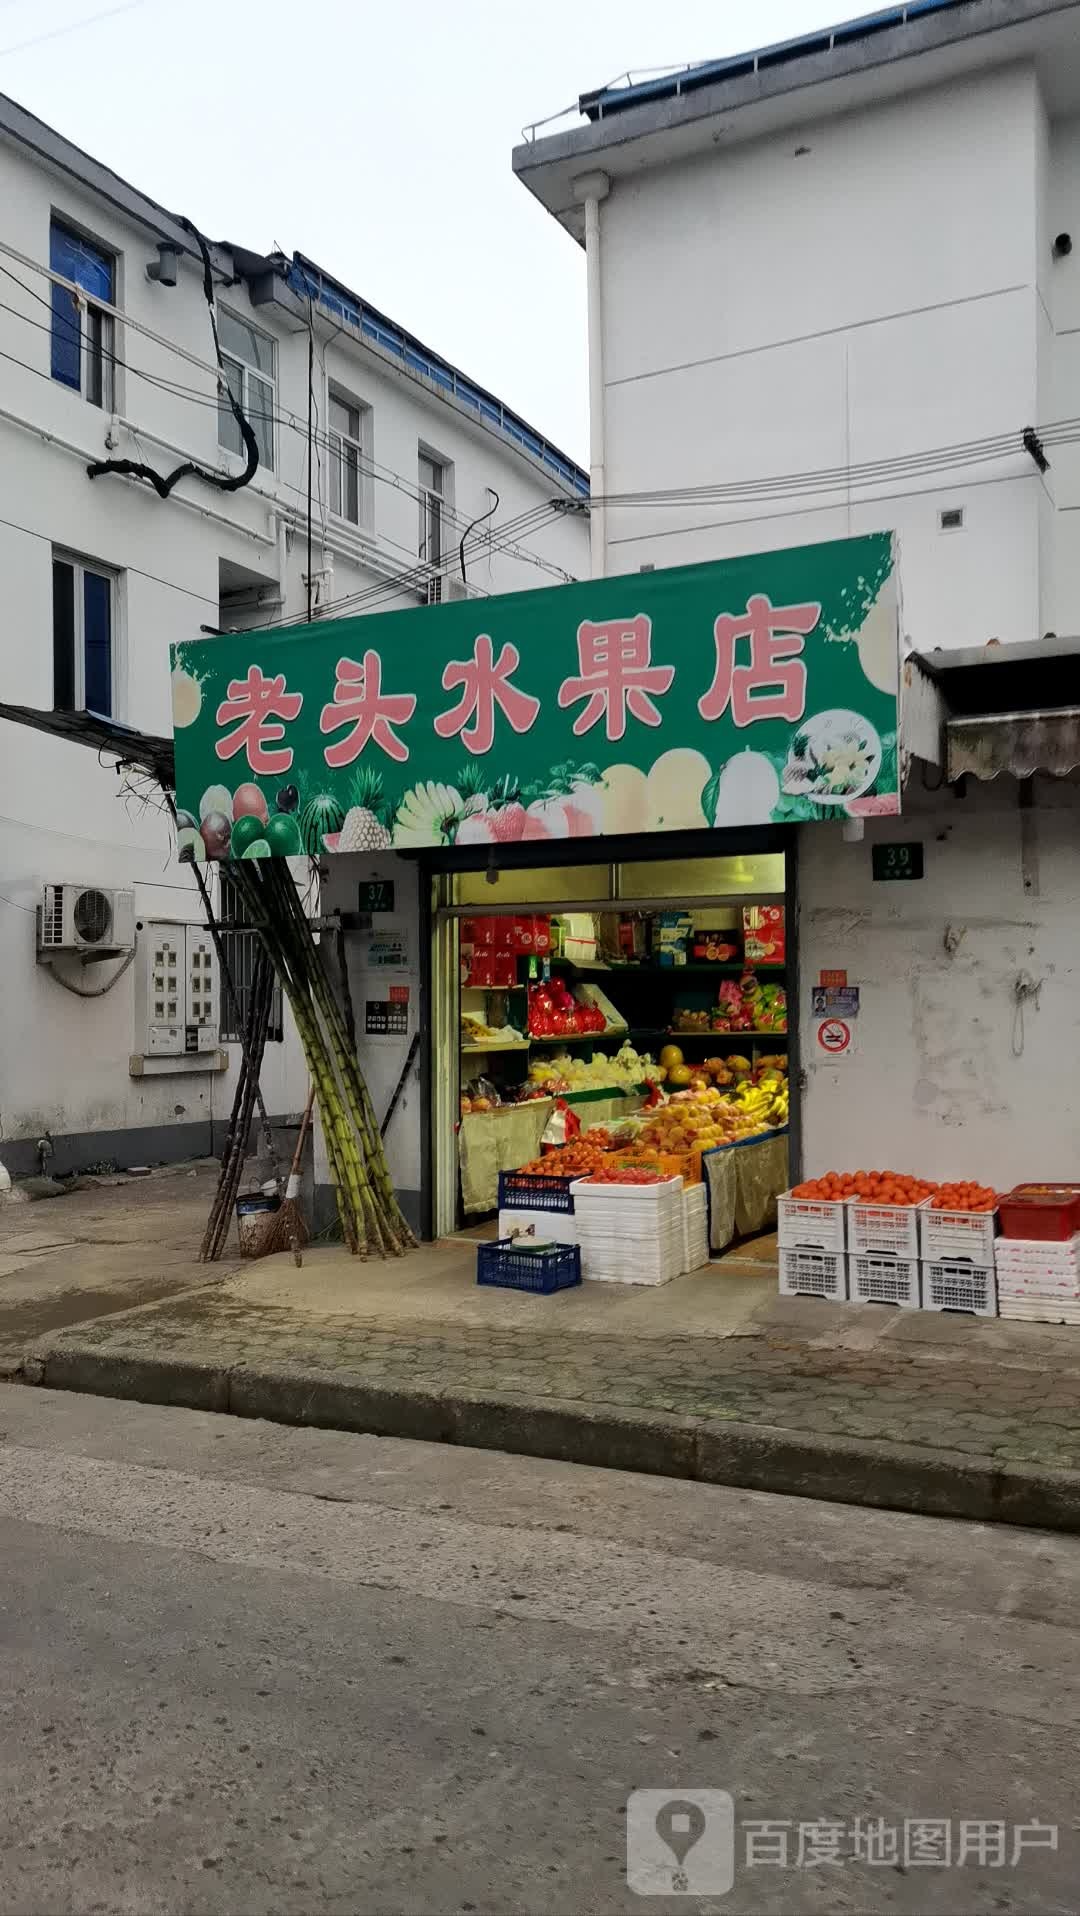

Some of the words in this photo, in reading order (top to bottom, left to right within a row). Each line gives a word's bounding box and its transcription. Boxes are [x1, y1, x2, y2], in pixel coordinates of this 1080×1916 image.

[214, 594, 822, 775] 老头水果店
[888, 848, 909, 866] 39
[368, 884, 385, 901] 37
